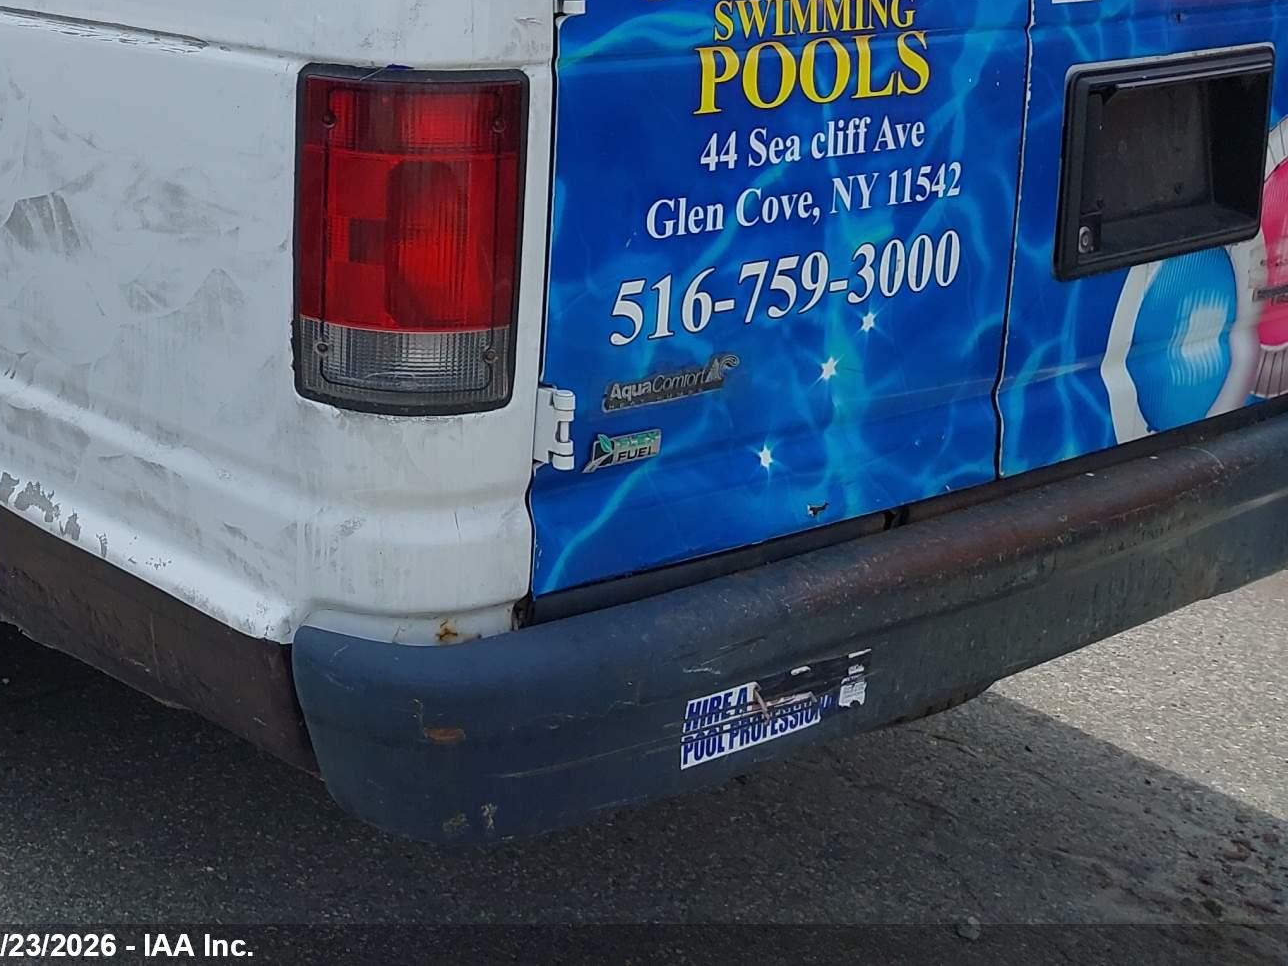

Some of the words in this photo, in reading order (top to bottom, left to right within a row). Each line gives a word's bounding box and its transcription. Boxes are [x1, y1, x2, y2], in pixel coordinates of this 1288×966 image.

[692, 31, 931, 115] POOLS
[700, 133, 737, 171] 44
[748, 128, 800, 167] Sea
[811, 117, 867, 160] cliff
[877, 116, 925, 152] Ave
[647, 199, 723, 239] Glen
[736, 189, 820, 225] Cove,
[831, 172, 879, 214] NY
[888, 161, 961, 205] 11542
[610, 231, 961, 346] 516-759-3000
[682, 727, 725, 765] POOL
[729, 698, 832, 750] PROFESSION
